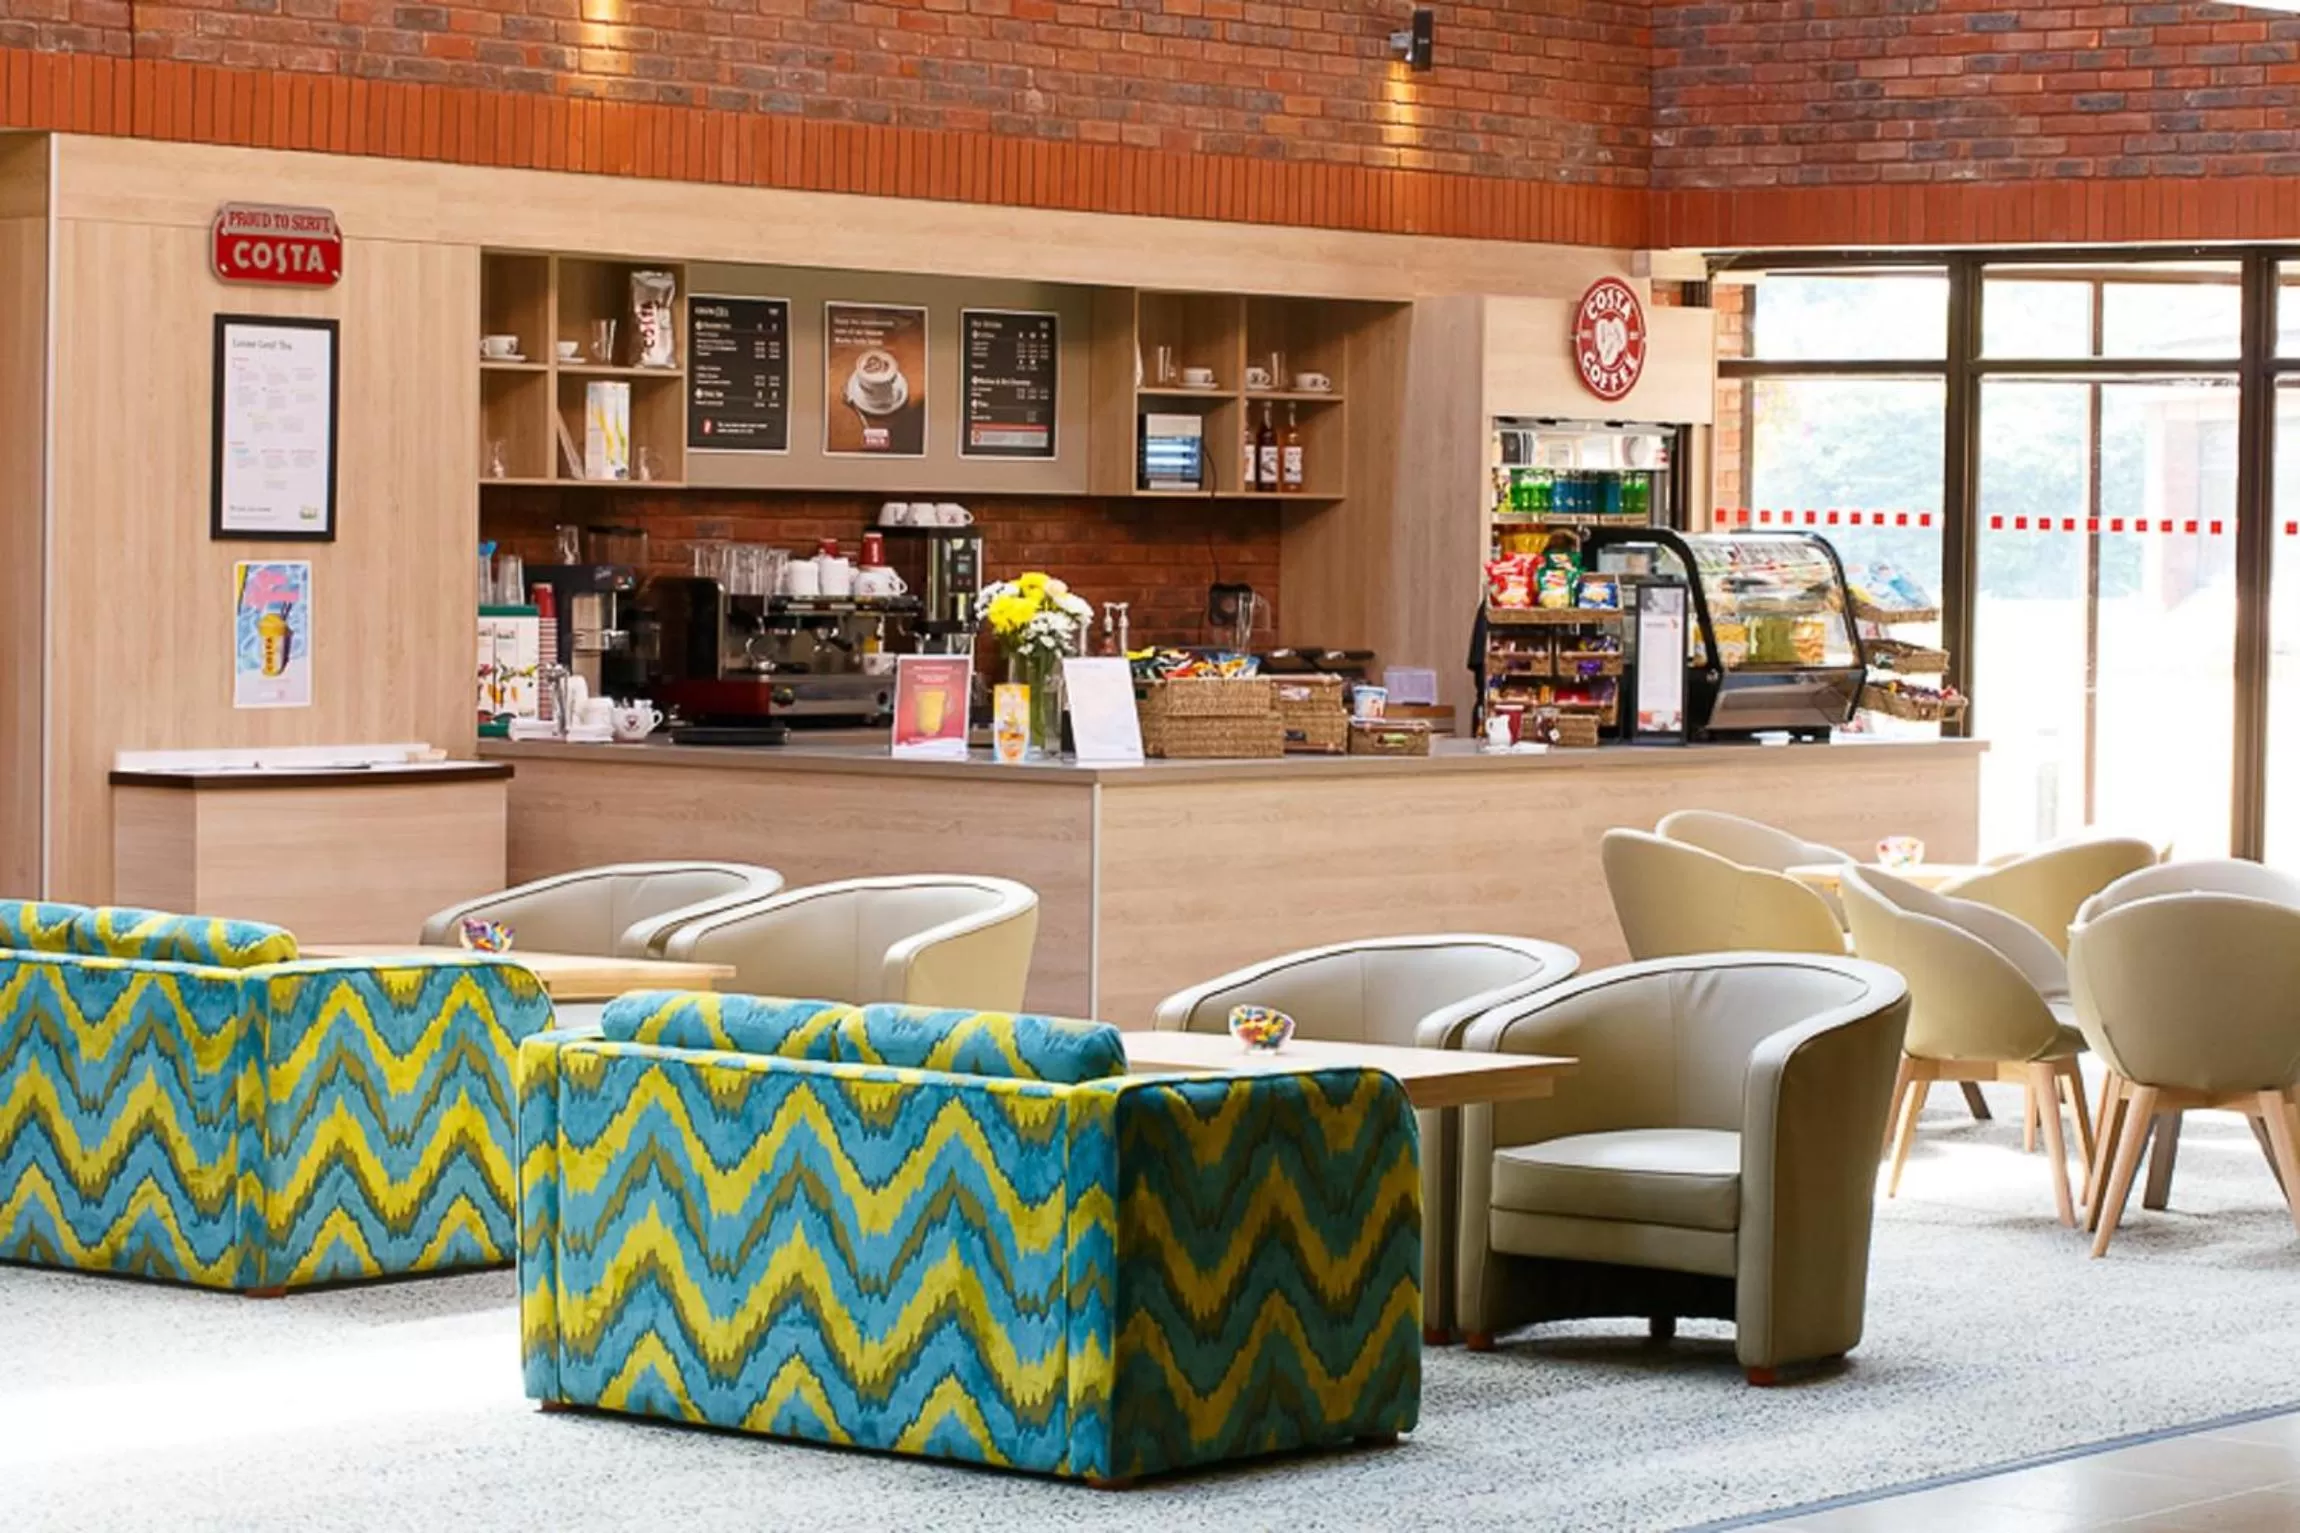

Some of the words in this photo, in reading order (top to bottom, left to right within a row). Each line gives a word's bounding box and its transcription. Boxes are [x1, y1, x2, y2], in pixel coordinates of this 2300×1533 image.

[229, 211, 272, 229] PROUD
[273, 213, 290, 230] TO
[291, 214, 331, 233] SERVE
[233, 240, 325, 274] COSTA
[1586, 288, 1631, 320] COSTA
[1584, 352, 1637, 391] COFFEE
